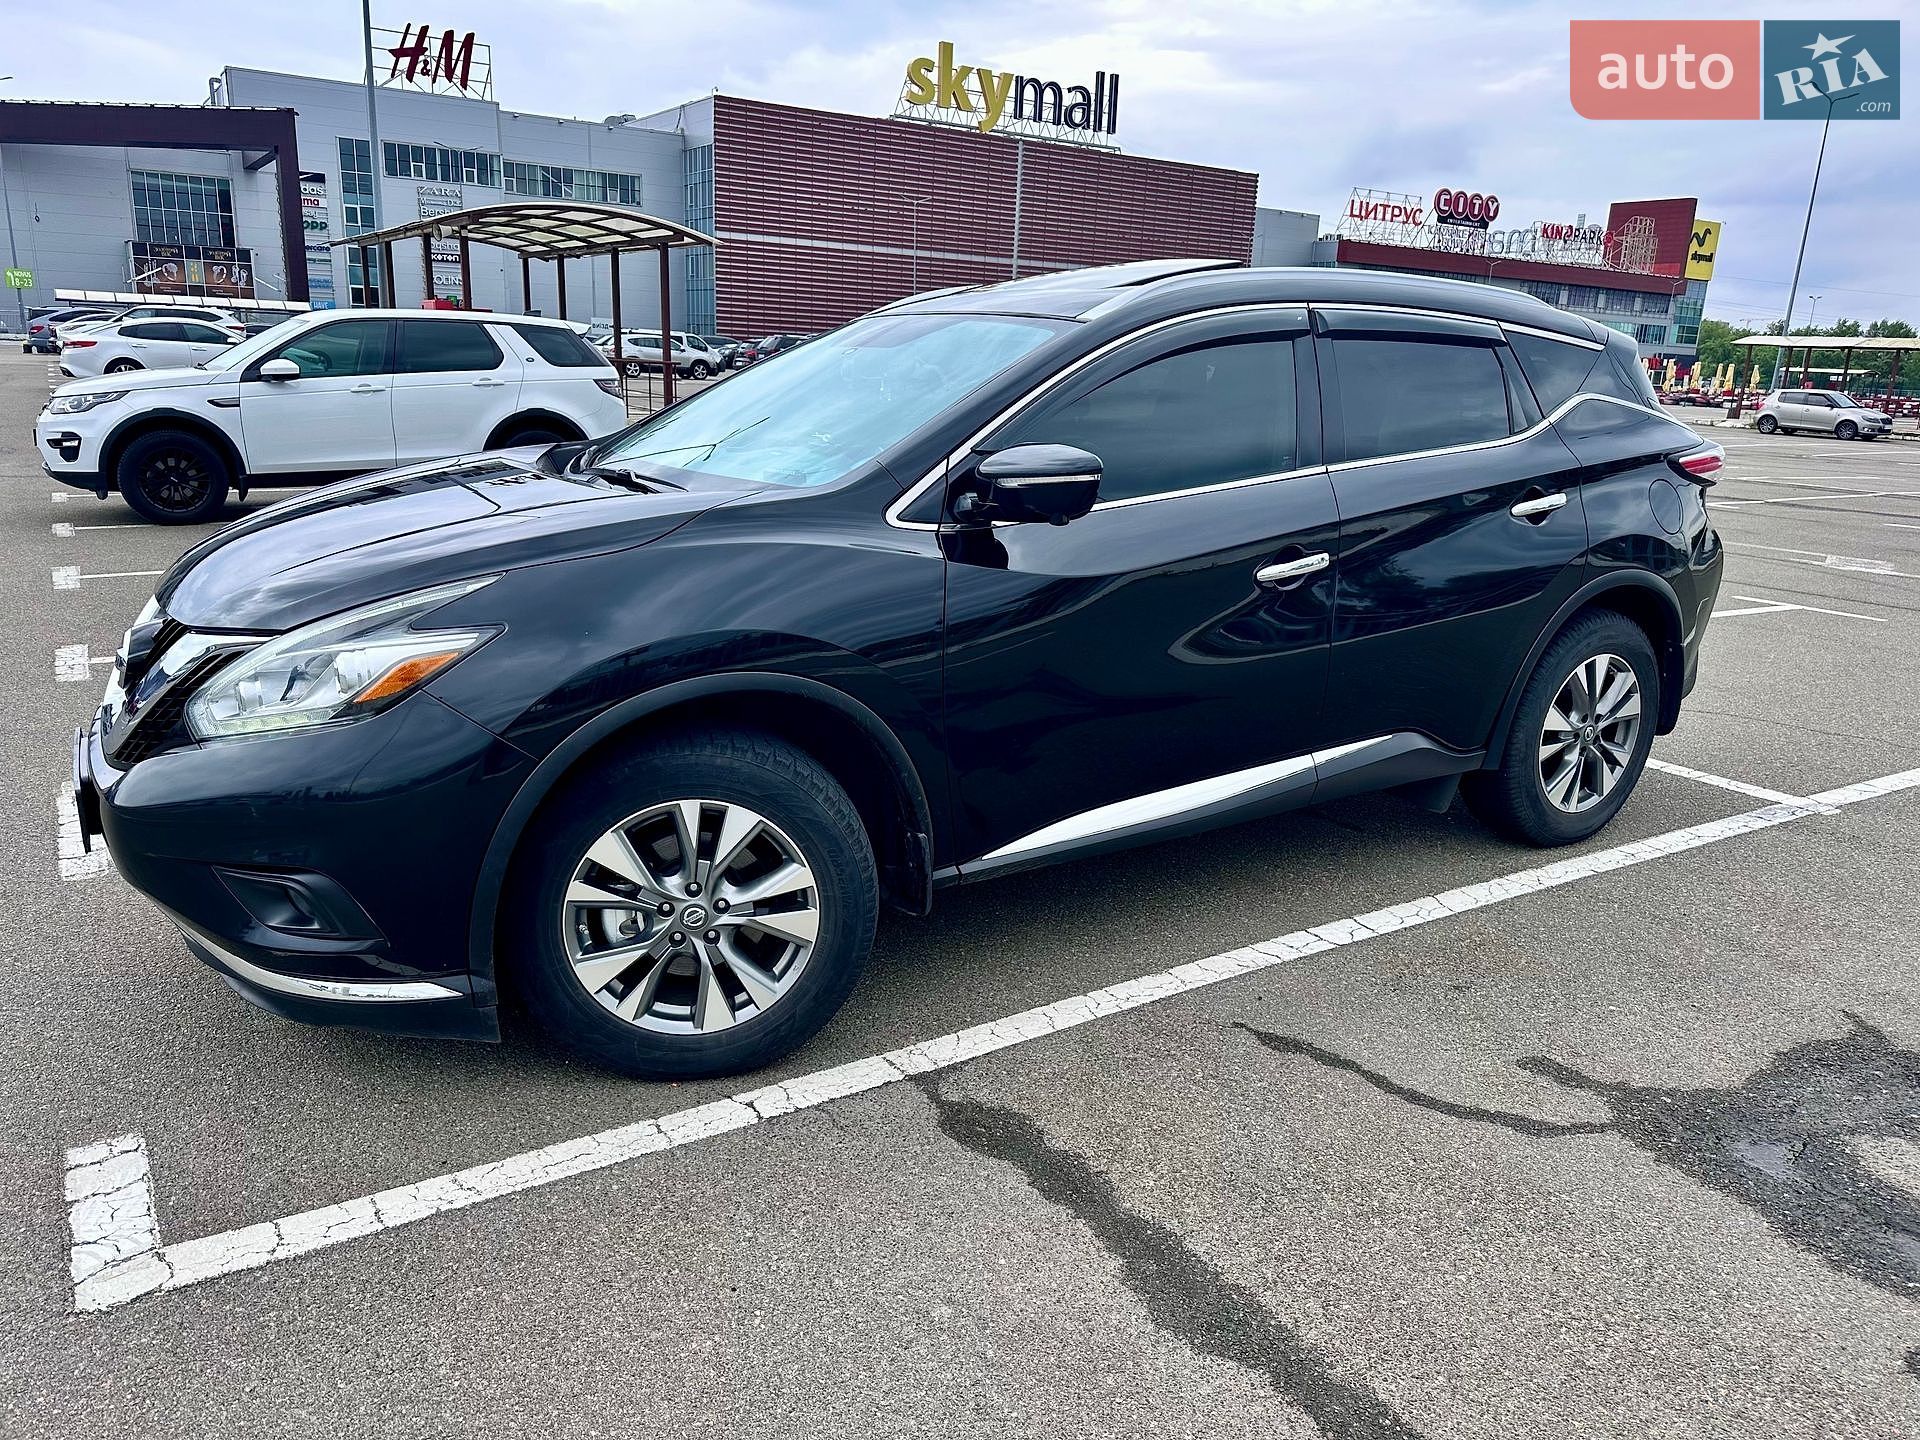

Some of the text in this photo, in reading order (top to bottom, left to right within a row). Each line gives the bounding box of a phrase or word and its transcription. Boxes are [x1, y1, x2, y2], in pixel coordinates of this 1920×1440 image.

[388, 22, 475, 91] H&M
[1349, 199, 1423, 227] ЦИТРУС
[1437, 190, 1499, 220] CITY
